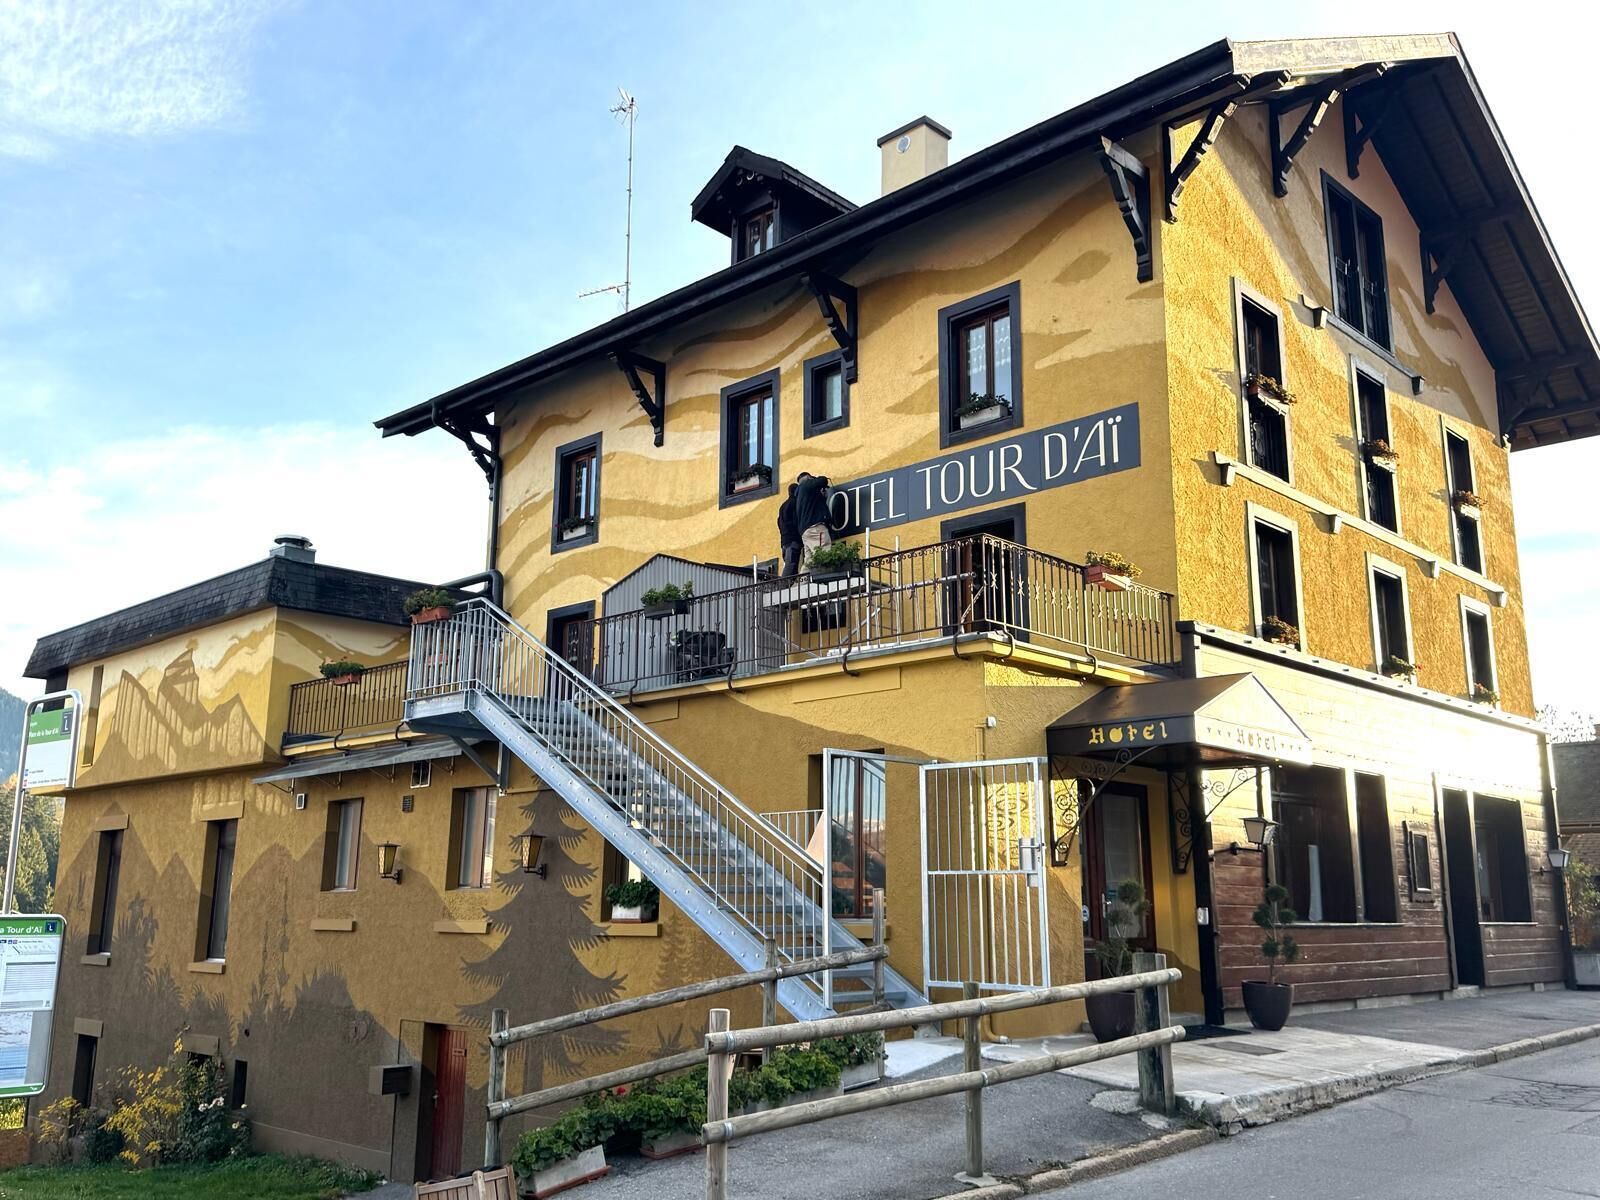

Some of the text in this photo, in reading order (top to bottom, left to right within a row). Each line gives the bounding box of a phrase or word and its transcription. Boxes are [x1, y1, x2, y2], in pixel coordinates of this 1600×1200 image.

[828, 415, 1122, 531] OTEL TOUR D'AÏ
[7, 926, 24, 934] Tour
[25, 925, 43, 934] d'Aï
